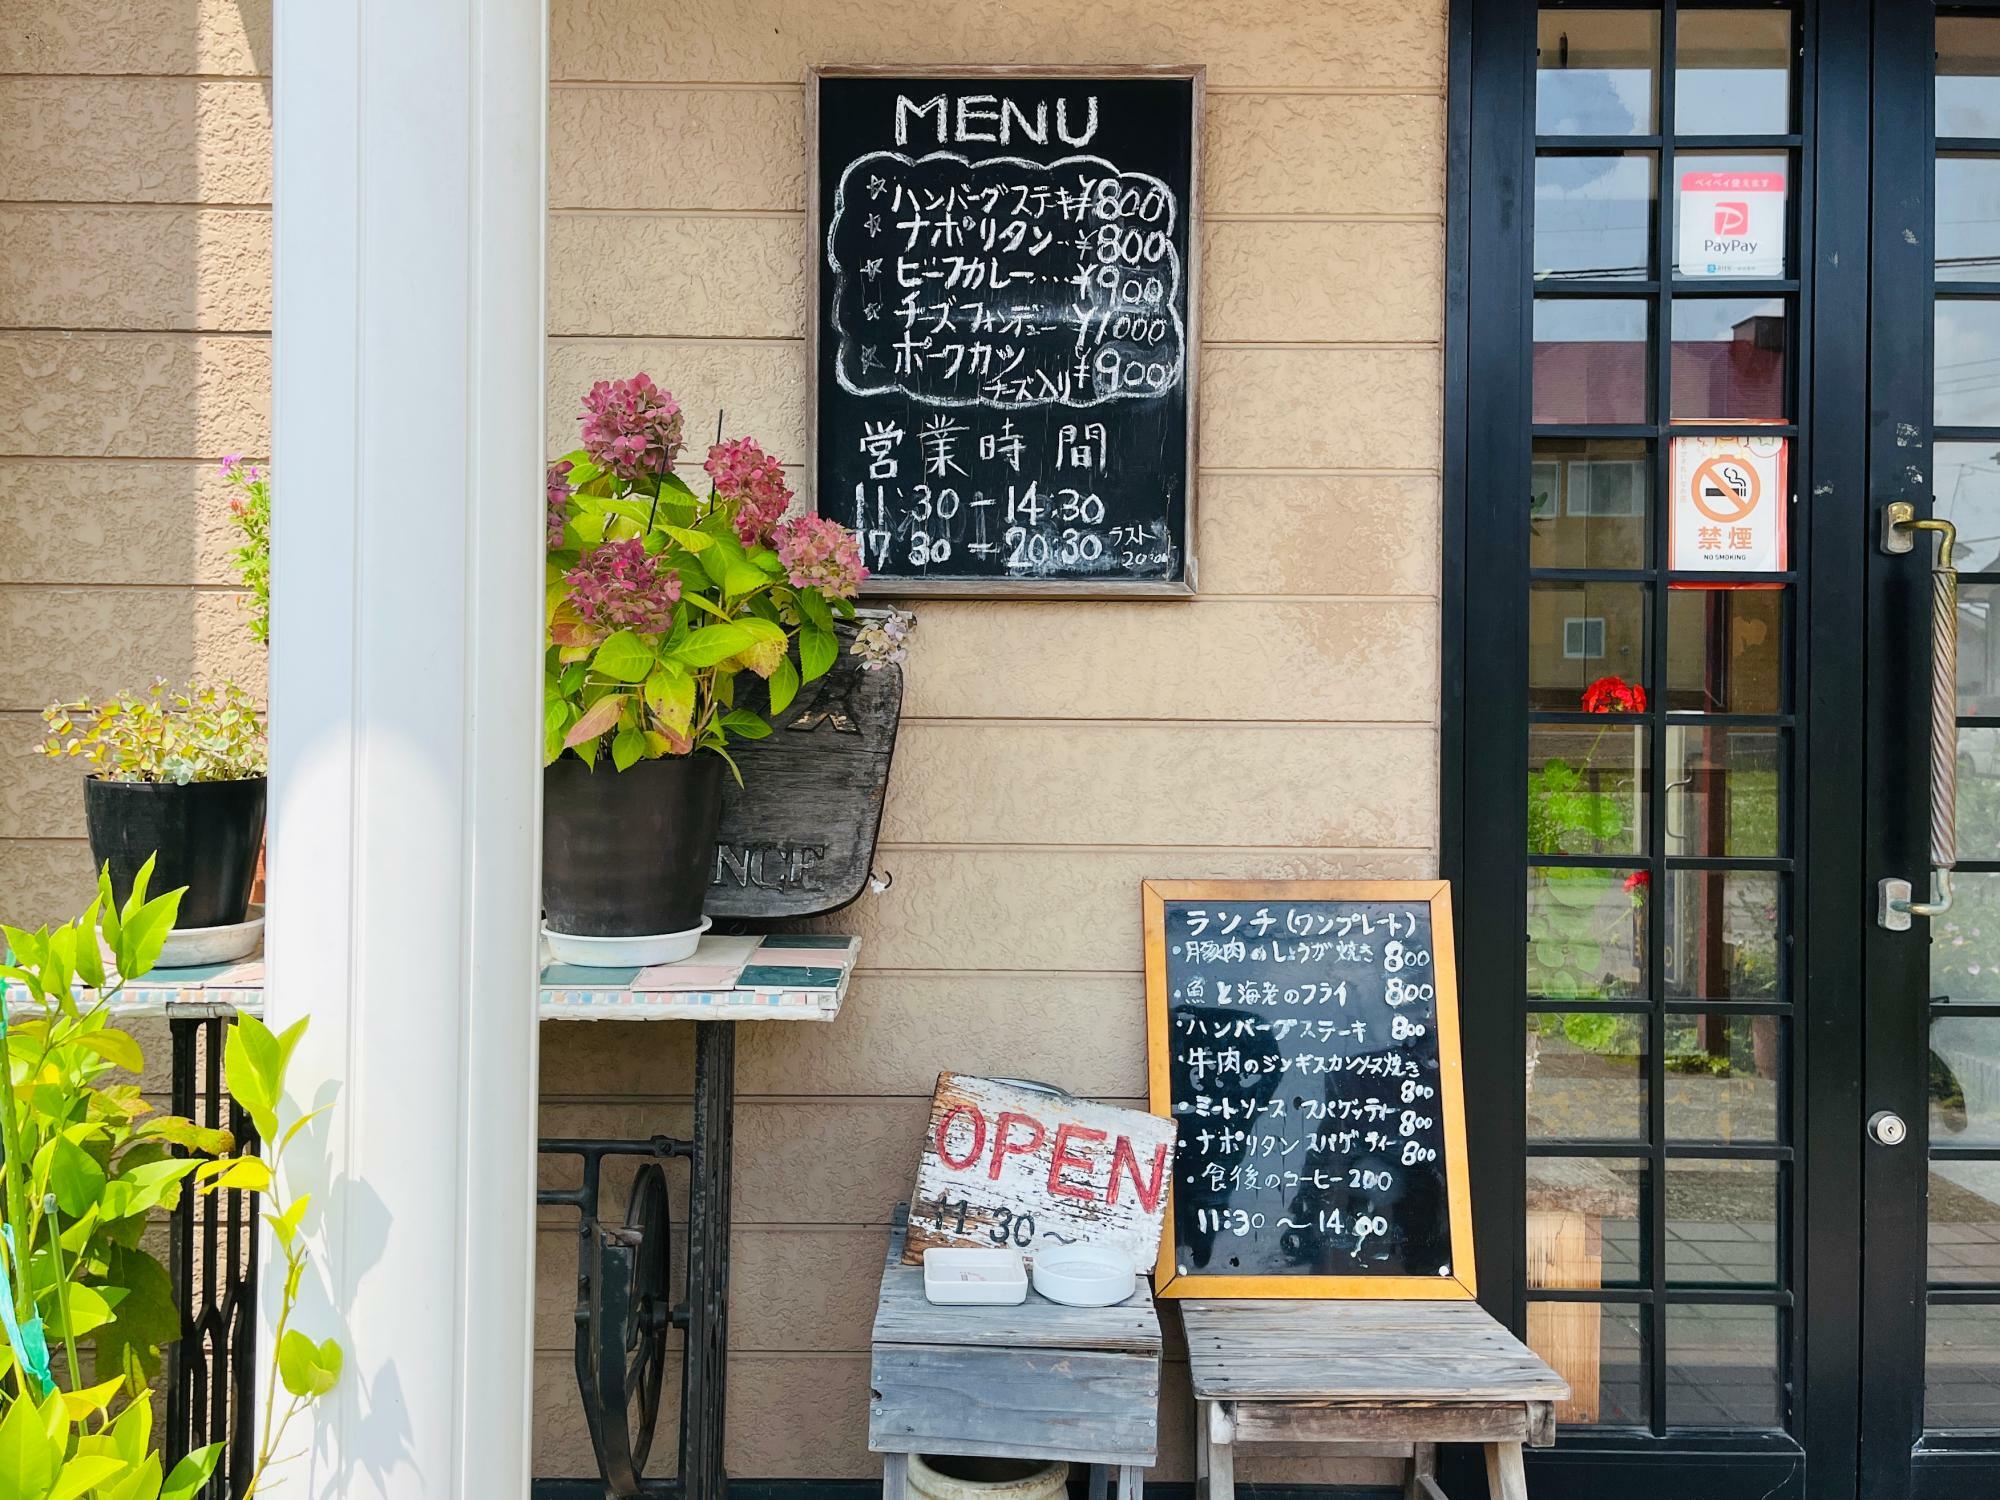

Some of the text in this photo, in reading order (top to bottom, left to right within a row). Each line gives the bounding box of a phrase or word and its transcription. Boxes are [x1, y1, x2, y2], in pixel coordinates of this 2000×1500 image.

[895, 93, 1099, 147] MENU
[896, 211, 1166, 263] ナポリタン ¥800
[1704, 239, 1758, 254] PayPay
[897, 257, 1164, 305] ビーフカレー ¥900
[893, 331, 1167, 390] ポークカツ ¥900
[860, 413, 1108, 479] 営業時間
[1109, 524, 1156, 547] ラスト
[1698, 526, 1753, 550] 禁煙
[1383, 940, 1431, 972] 800
[1185, 976, 1435, 1007] 魚と海老のフライ 800
[1391, 1015, 1426, 1041] 800
[1400, 1079, 1434, 1103] 800
[1399, 1110, 1433, 1137] 800
[935, 1104, 1168, 1214] OPEN
[1401, 1140, 1437, 1166] 800
[1202, 1162, 1394, 1192] 食後のコーヒー 200
[1197, 1207, 1265, 1236] 11:30
